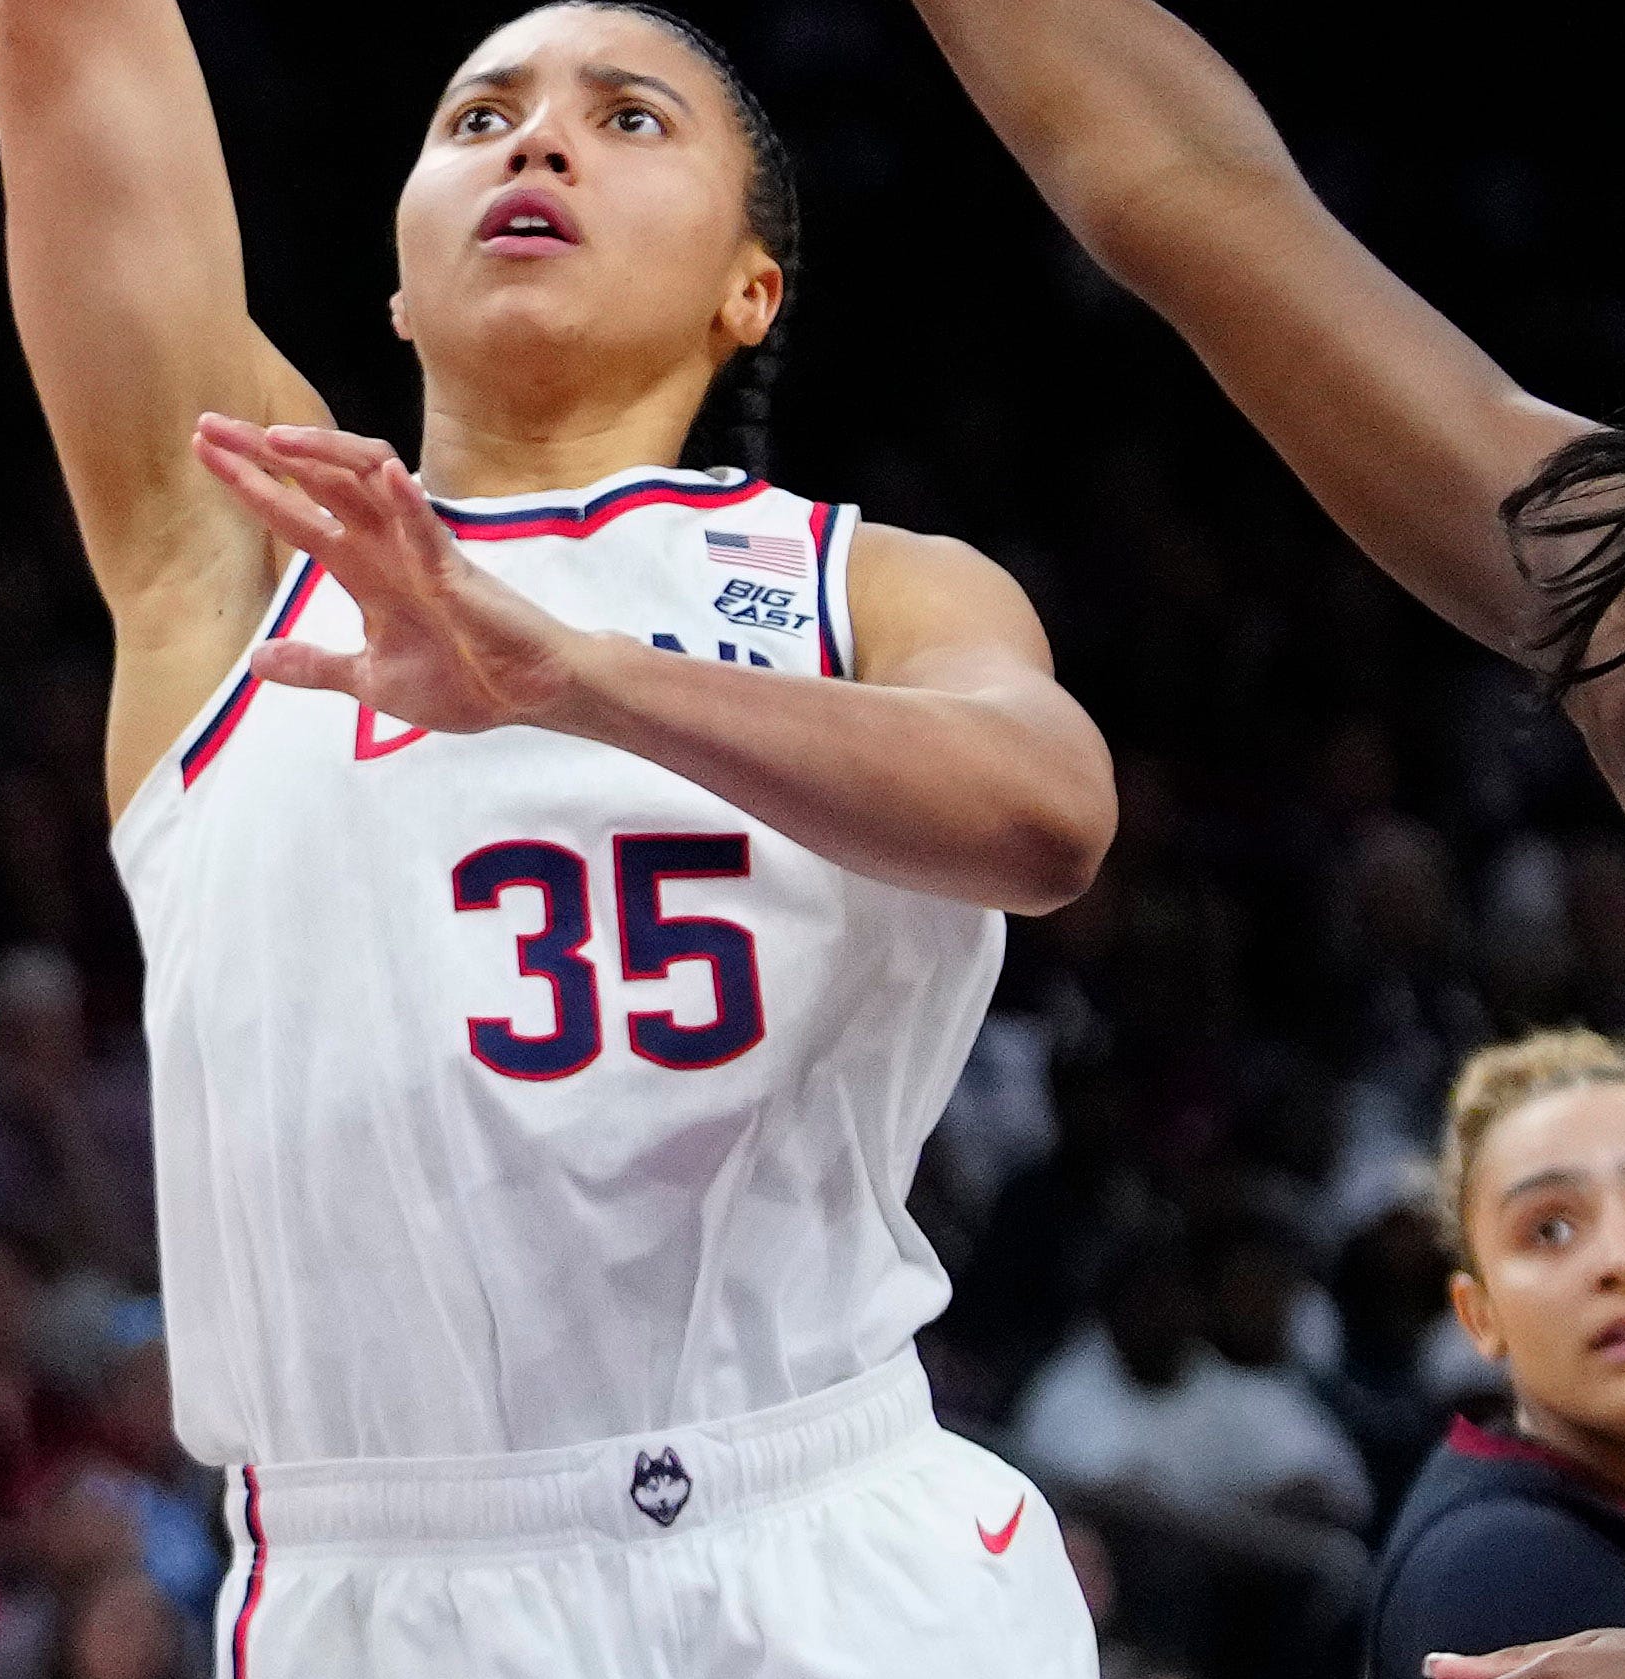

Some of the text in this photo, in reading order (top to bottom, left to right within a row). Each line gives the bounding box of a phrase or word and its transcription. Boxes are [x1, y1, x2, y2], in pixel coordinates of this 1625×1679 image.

[722, 578, 798, 607] BIG
[713, 595, 815, 630] EAST
[451, 831, 767, 1083] 35
